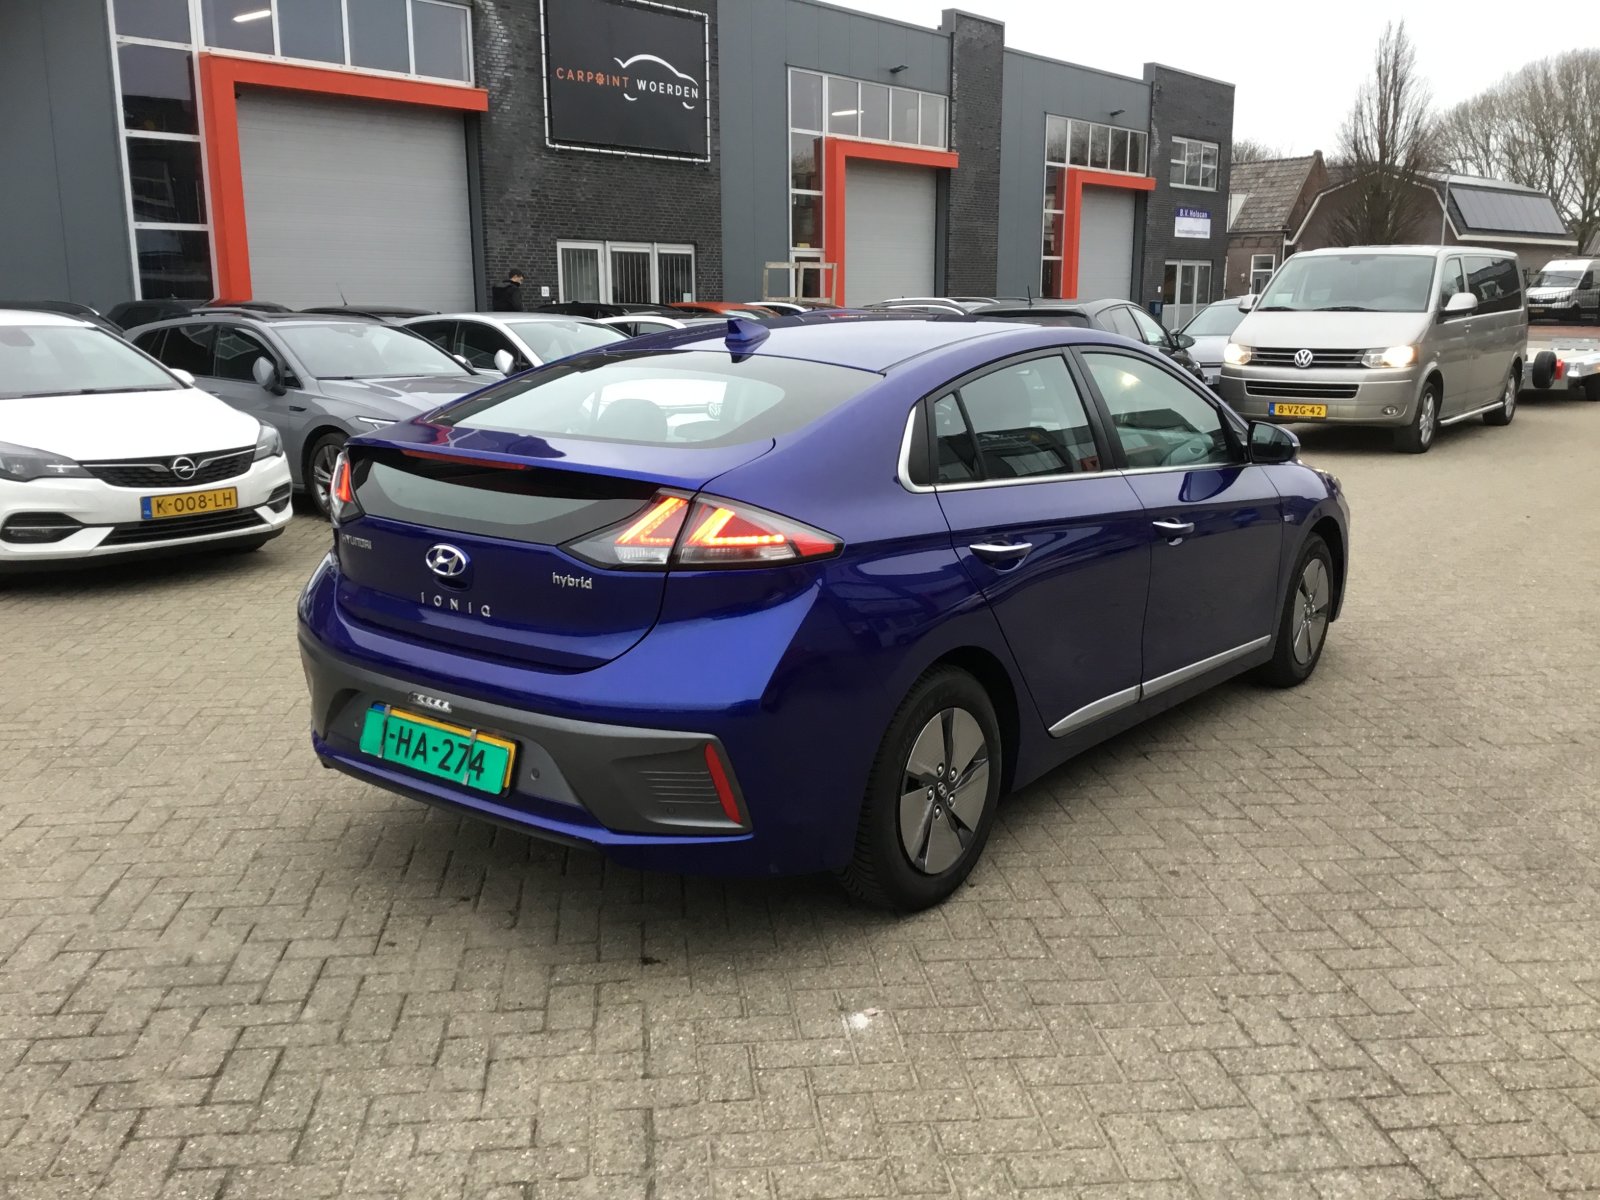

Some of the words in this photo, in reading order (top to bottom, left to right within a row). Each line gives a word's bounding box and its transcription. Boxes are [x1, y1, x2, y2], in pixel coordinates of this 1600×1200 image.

[556, 67, 630, 88] CARPOINT
[636, 79, 699, 99] WOERDEN
[1278, 404, 1322, 416] 8-VZG-42
[156, 491, 232, 514] K-008-LH
[552, 571, 593, 590] hybrid
[420, 591, 492, 618] IONIQ
